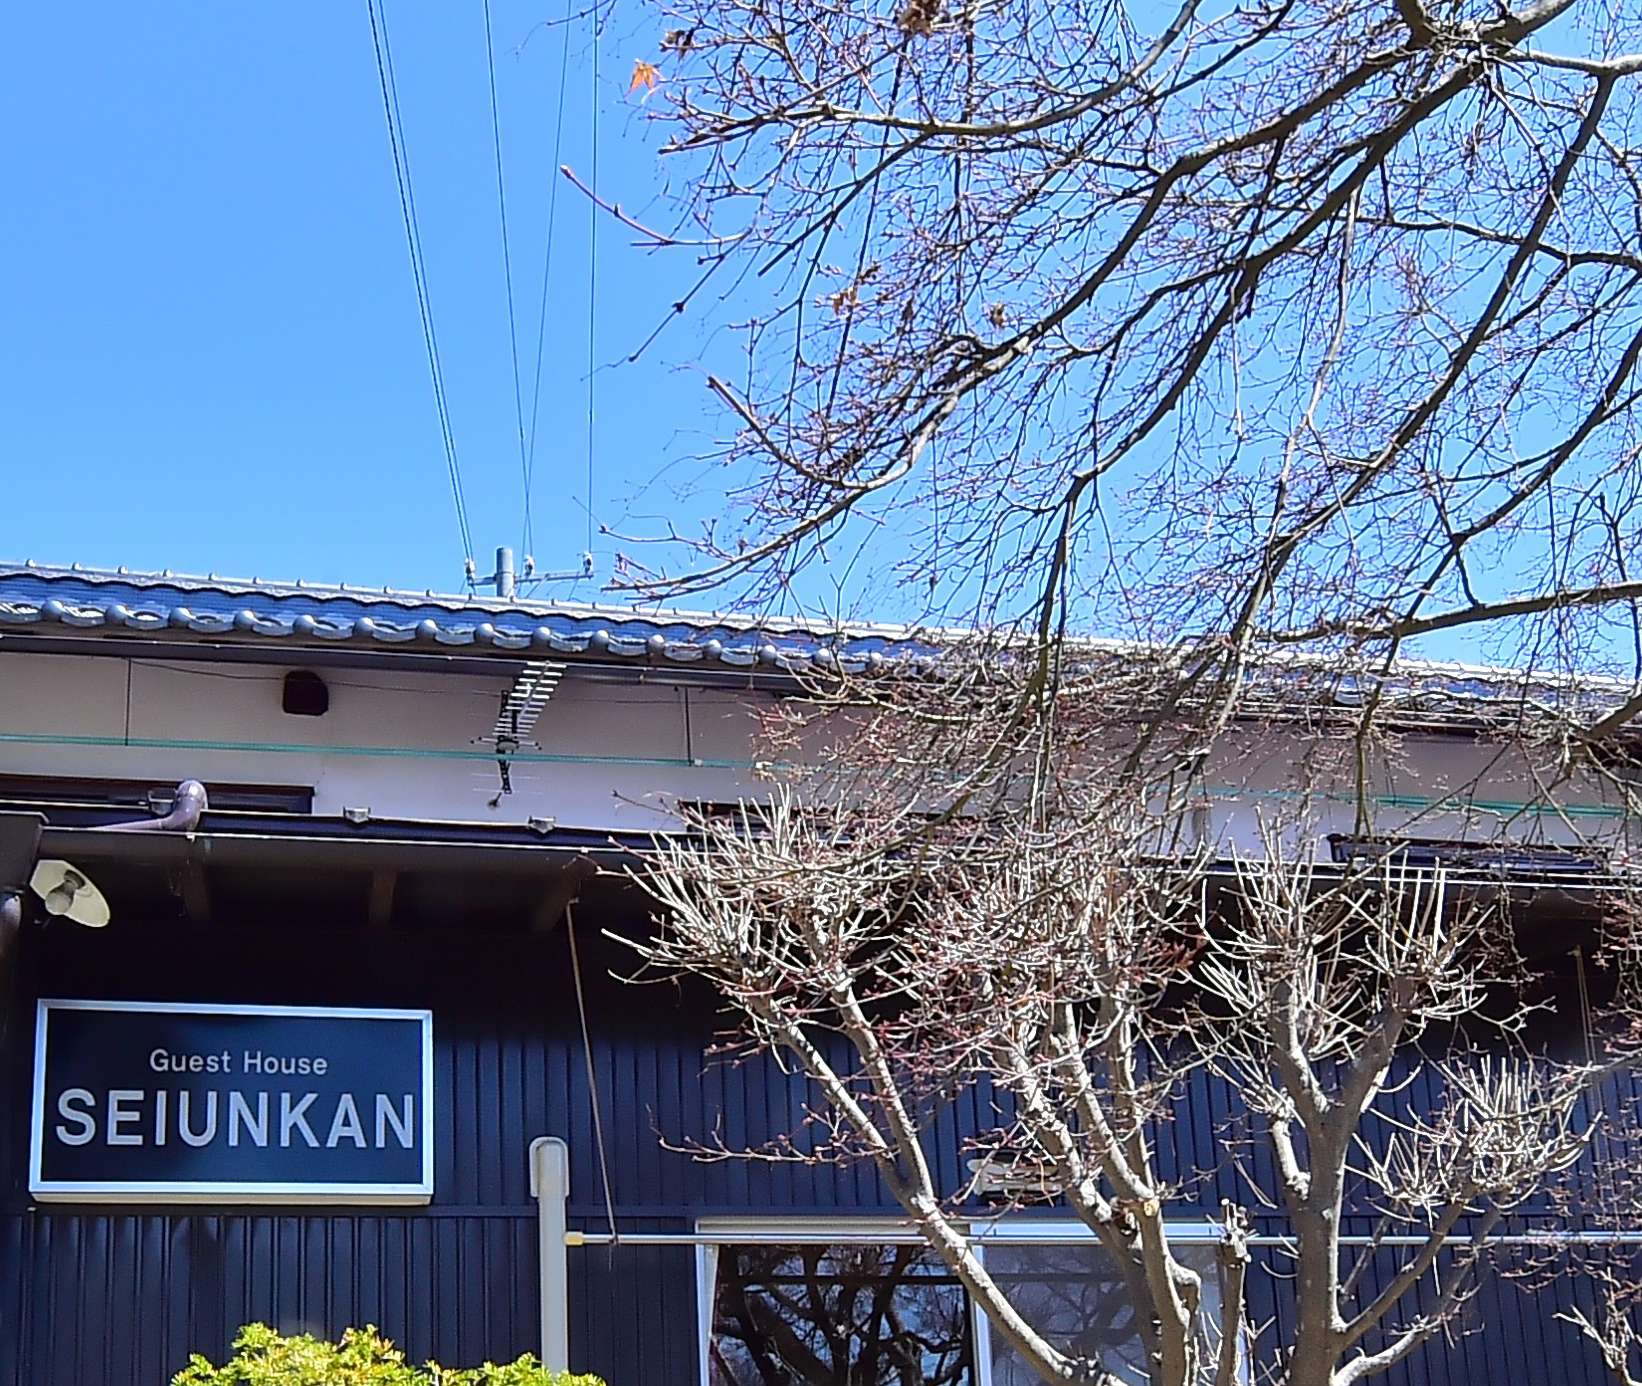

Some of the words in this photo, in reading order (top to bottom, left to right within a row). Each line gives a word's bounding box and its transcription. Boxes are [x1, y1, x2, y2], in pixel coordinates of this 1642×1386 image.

[149, 1048, 232, 1073] Guest
[243, 1051, 329, 1075] House
[55, 1088, 414, 1149] SEIUNKAN
